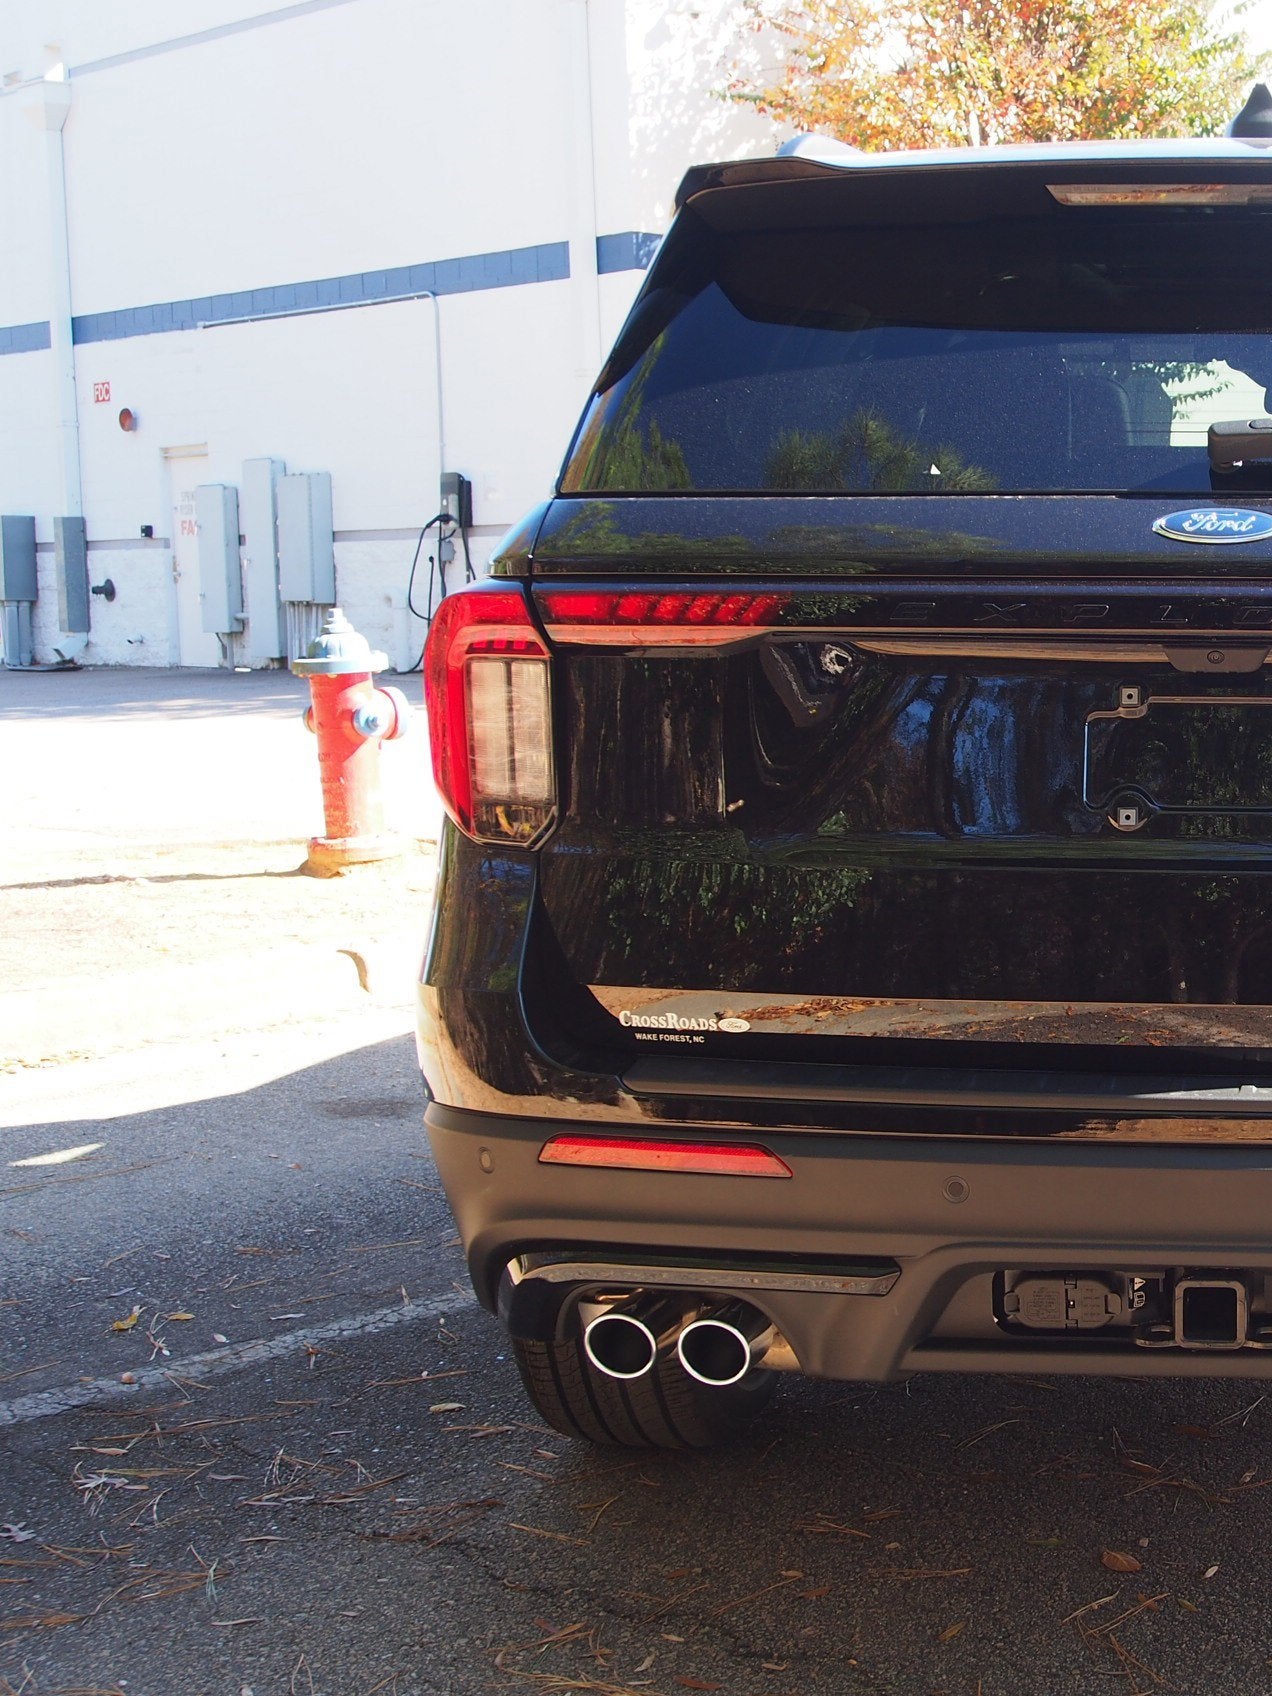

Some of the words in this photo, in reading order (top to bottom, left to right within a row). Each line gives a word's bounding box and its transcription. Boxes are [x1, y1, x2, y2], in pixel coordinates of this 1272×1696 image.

[95, 383, 110, 401] FDC
[1182, 511, 1256, 532] Ford
[635, 1032, 657, 1041] WAKE
[659, 1034, 692, 1043] FOREST,
[693, 1035, 705, 1043] NC
